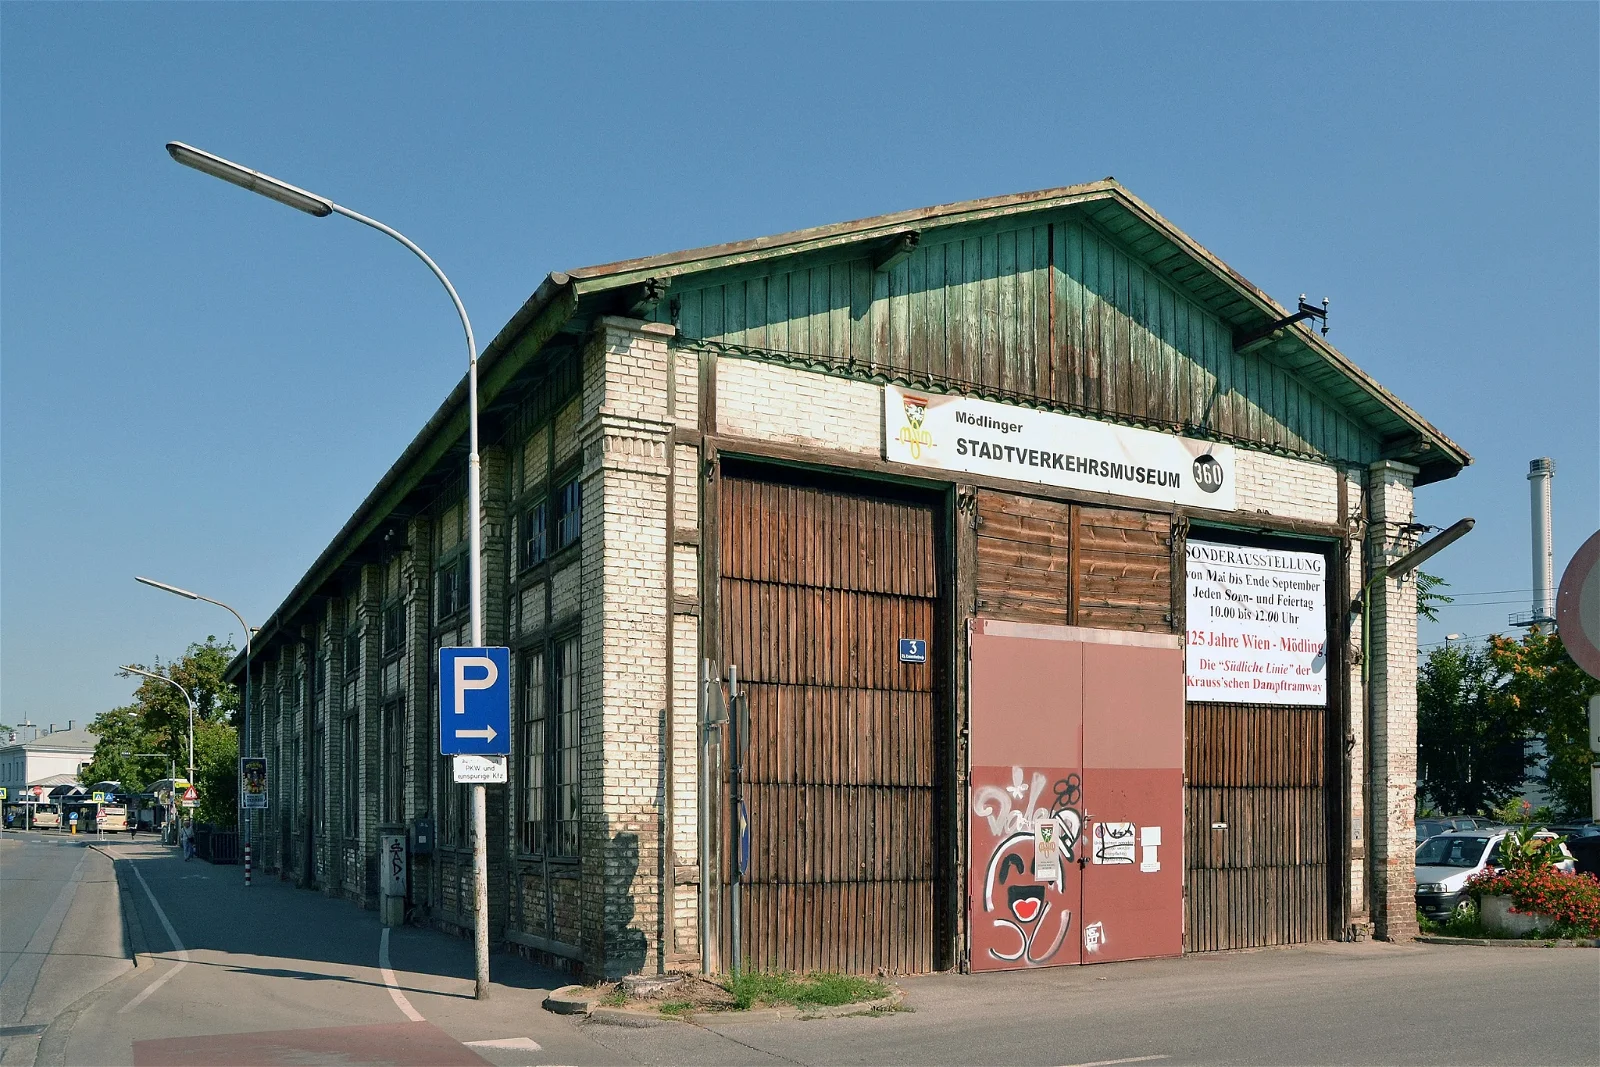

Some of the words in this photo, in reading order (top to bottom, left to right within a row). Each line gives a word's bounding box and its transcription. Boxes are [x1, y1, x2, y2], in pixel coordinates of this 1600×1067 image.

[955, 411, 1023, 433] Mödlinger
[956, 438, 1181, 488] STADTVERKEHRSMUSEUM
[1194, 462, 1222, 485] 360
[1186, 545, 1322, 572] SONDERAUSSTELLUNG
[1186, 571, 1203, 580] von
[1206, 569, 1226, 582] Mai
[1229, 571, 1243, 585] bis
[1246, 574, 1270, 588] Ende
[1272, 576, 1321, 592] September
[1193, 586, 1222, 600] Jeden
[1225, 589, 1254, 603] Sonn-
[1256, 594, 1274, 605] und
[1277, 595, 1314, 611] Feiertag
[1210, 605, 1235, 619] 10.00
[1238, 607, 1251, 621] bis
[1255, 610, 1279, 622] 12.00
[1282, 612, 1300, 625] Uhr
[909, 641, 917, 655] 3
[1186, 630, 1205, 646] 125
[1207, 631, 1239, 648] Jahre
[1242, 633, 1270, 650] Wien
[1280, 636, 1323, 656] Mödling
[1199, 658, 1216, 671] Die
[1219, 660, 1263, 673] “Südliche
[1295, 664, 1311, 676] der
[454, 657, 498, 714] P
[1253, 678, 1323, 694] Dampftramway
